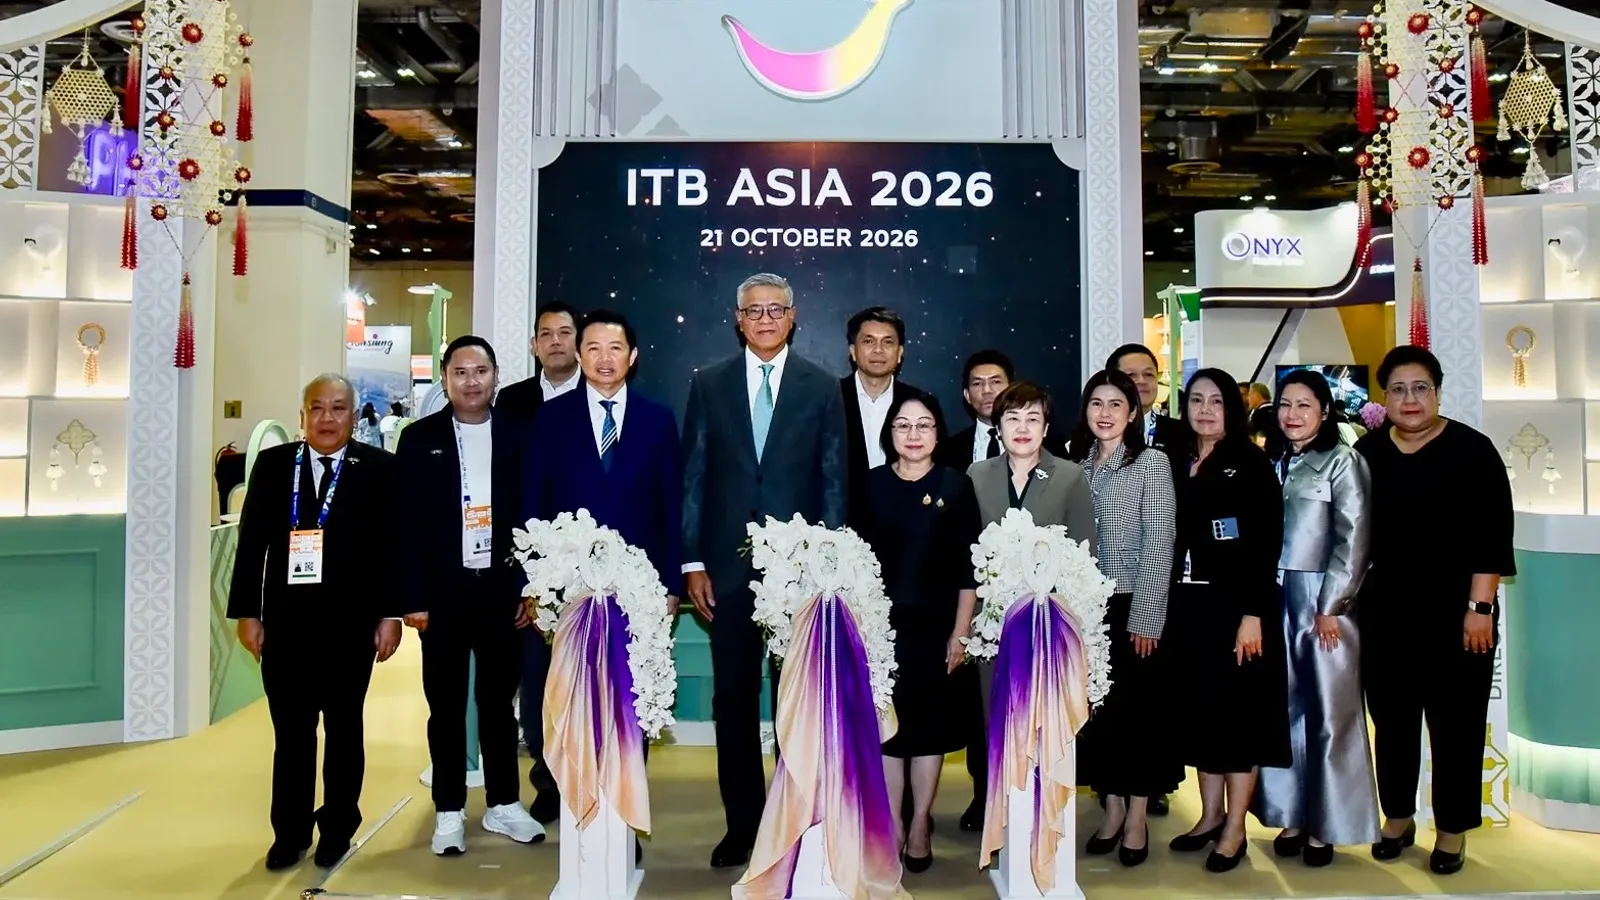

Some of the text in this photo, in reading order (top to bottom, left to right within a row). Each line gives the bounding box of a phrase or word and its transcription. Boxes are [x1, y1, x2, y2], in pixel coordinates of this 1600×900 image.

[628, 168, 993, 206] ITB ASIA 2026
[701, 228, 918, 247] 21 OCTOBER 2026
[1227, 232, 1303, 257] ONYX
